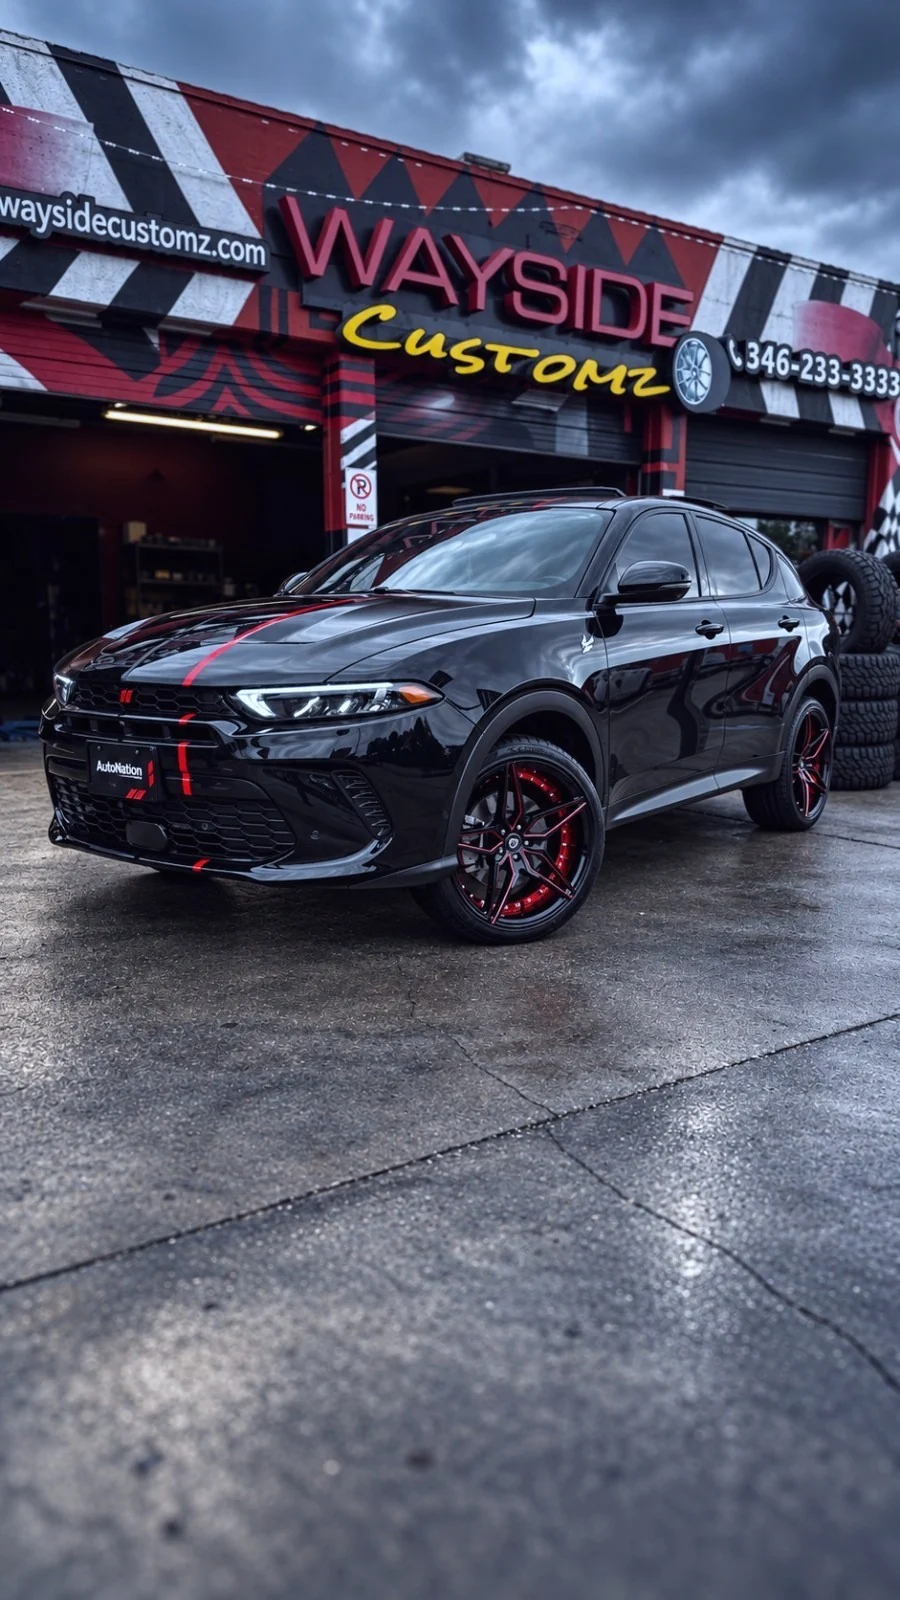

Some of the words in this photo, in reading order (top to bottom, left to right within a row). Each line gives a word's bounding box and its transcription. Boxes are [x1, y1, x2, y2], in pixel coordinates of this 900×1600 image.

[0, 196, 266, 266] waysidecustomz.com
[277, 195, 694, 348] WAYSIDE
[746, 341, 900, 397] 346-233-3333
[349, 512, 374, 522] PARKING
[356, 503, 367, 512] NO
[96, 760, 143, 777] AutoNation
